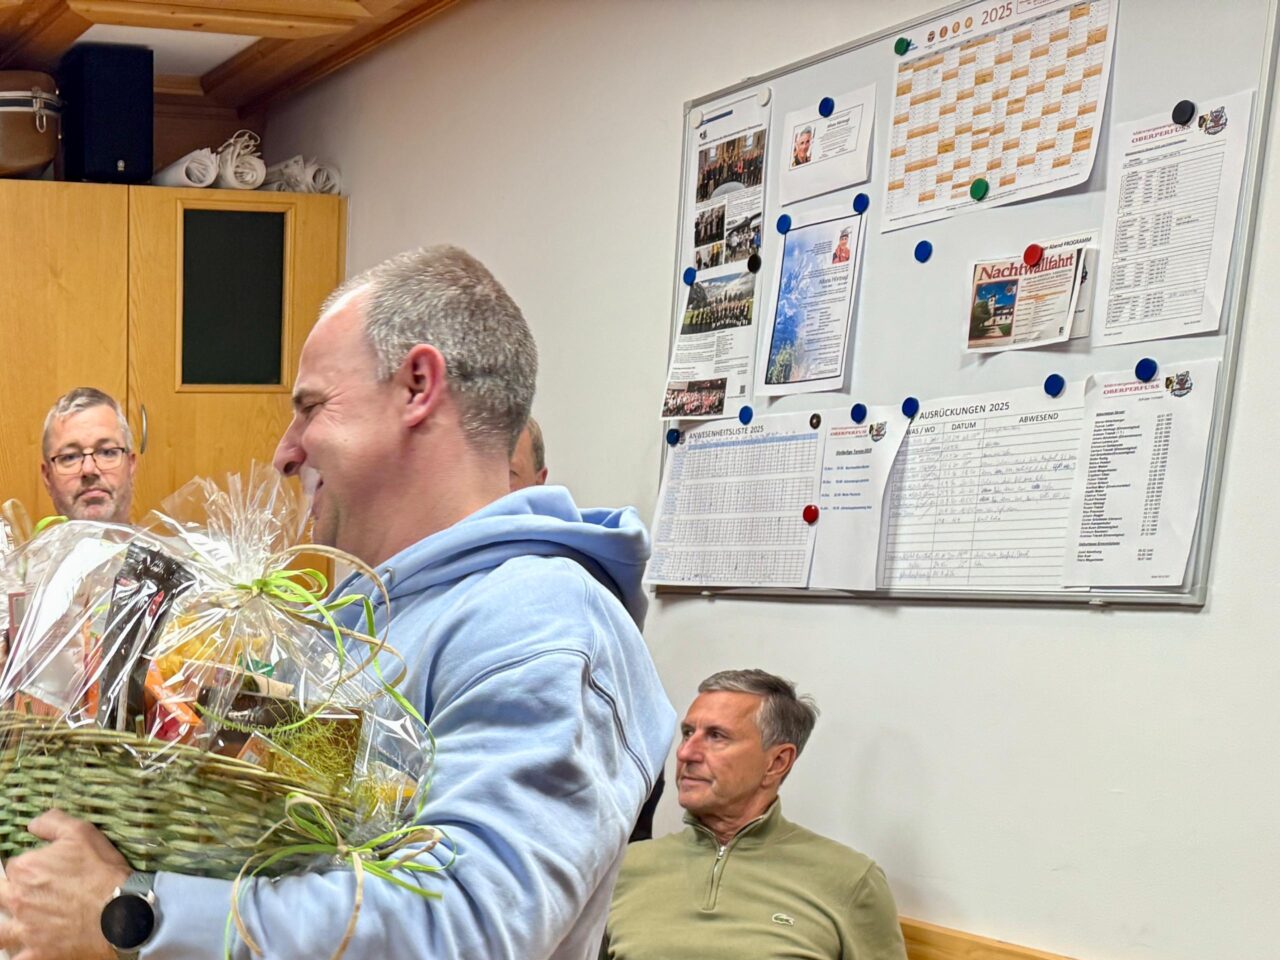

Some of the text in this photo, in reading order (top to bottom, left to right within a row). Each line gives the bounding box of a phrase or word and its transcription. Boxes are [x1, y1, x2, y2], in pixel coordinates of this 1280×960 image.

[981, 2, 1013, 26] 2025
[979, 253, 1074, 281] Nachtwallfahrt
[919, 401, 1010, 420] AUSRÜCKUNGEN 2025
[1019, 412, 1059, 424] ABWESEND
[688, 425, 764, 440] ANWESENHEITSLISTE 2025
[951, 422, 977, 431] DATUM
